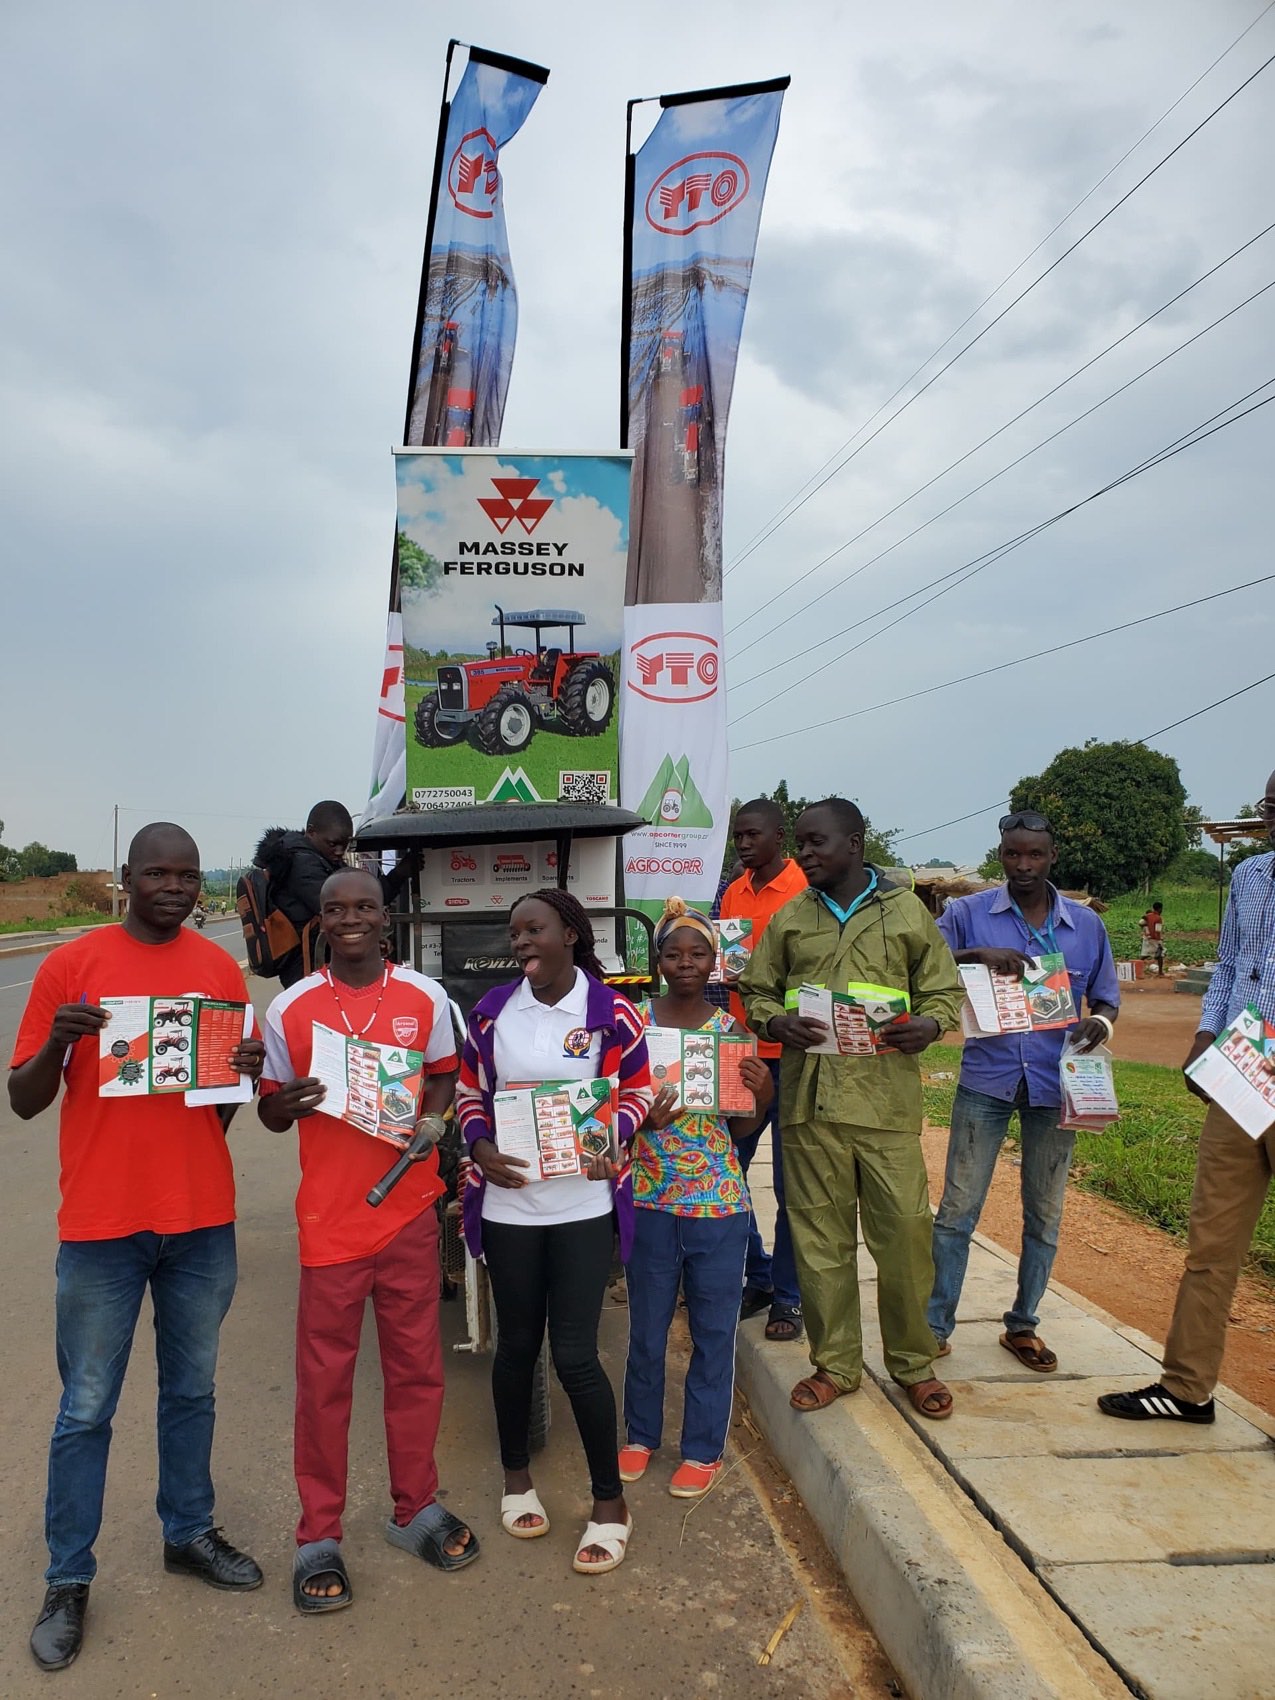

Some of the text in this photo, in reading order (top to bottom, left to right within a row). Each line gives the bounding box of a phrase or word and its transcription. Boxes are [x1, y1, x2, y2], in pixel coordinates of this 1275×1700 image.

[659, 169, 738, 220] YTO
[459, 541, 569, 557] MASSEY
[443, 561, 585, 577] FERGUSON
[636, 652, 718, 686] YTO
[414, 788, 473, 799] 0772750043
[654, 841, 672, 849] SINCE
